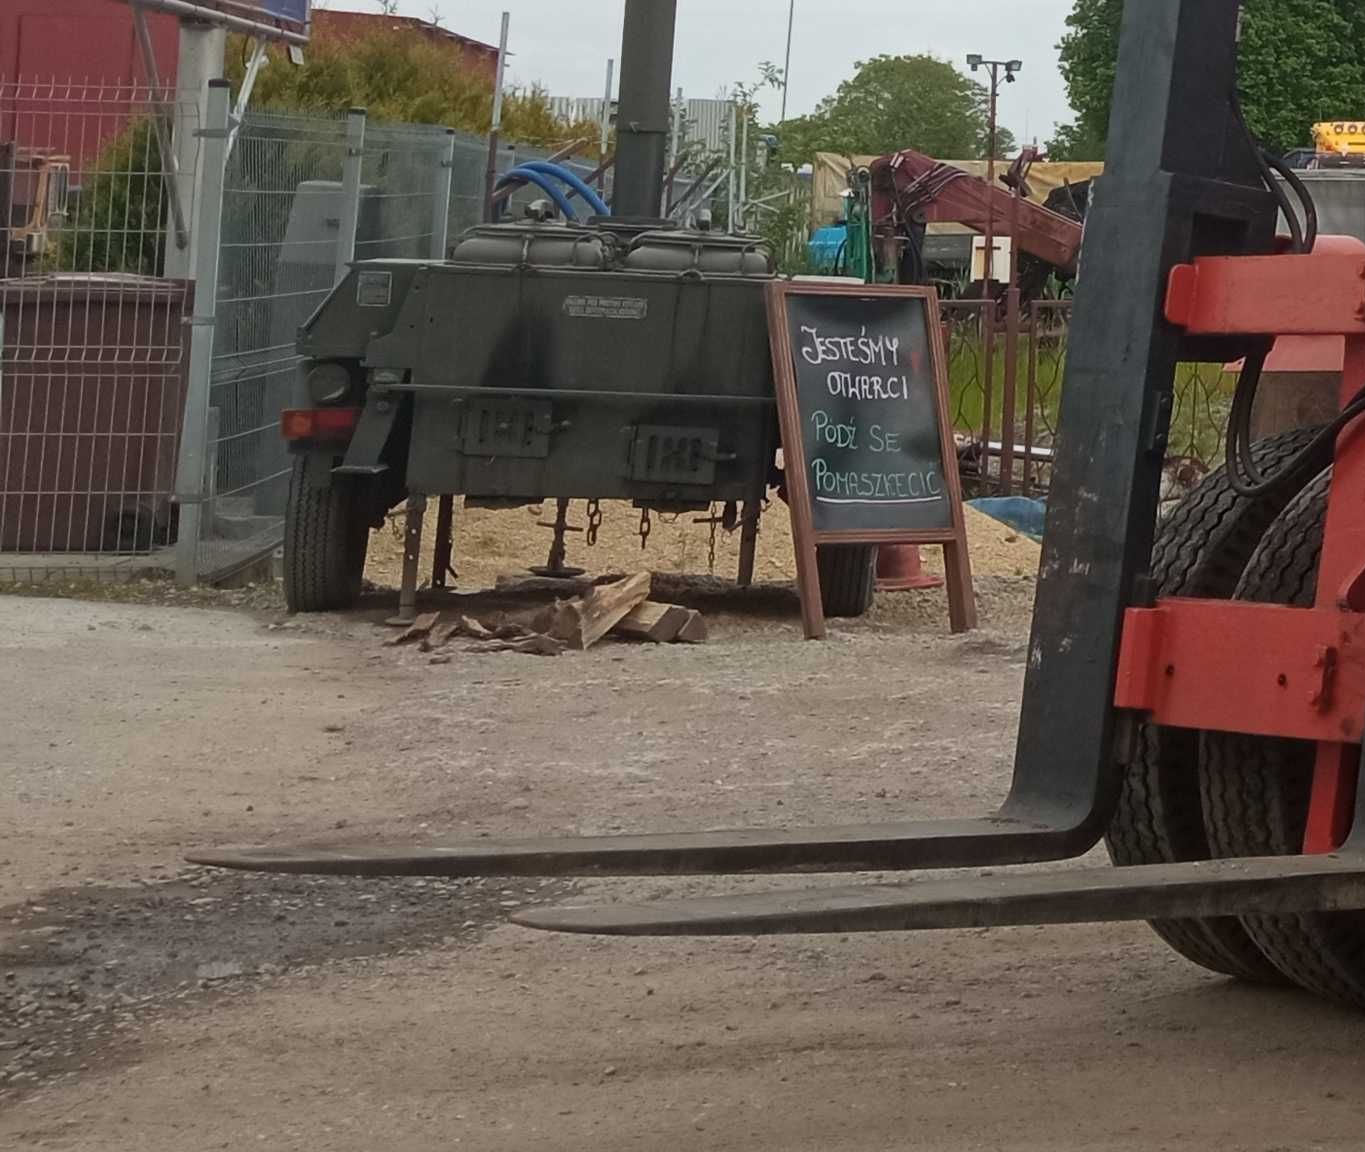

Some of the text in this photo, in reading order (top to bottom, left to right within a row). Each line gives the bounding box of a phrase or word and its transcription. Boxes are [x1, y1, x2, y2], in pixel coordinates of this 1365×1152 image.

[801, 325, 899, 366] JESTEŚMY
[827, 371, 908, 400] OTWARCI
[869, 424, 901, 452] SE
